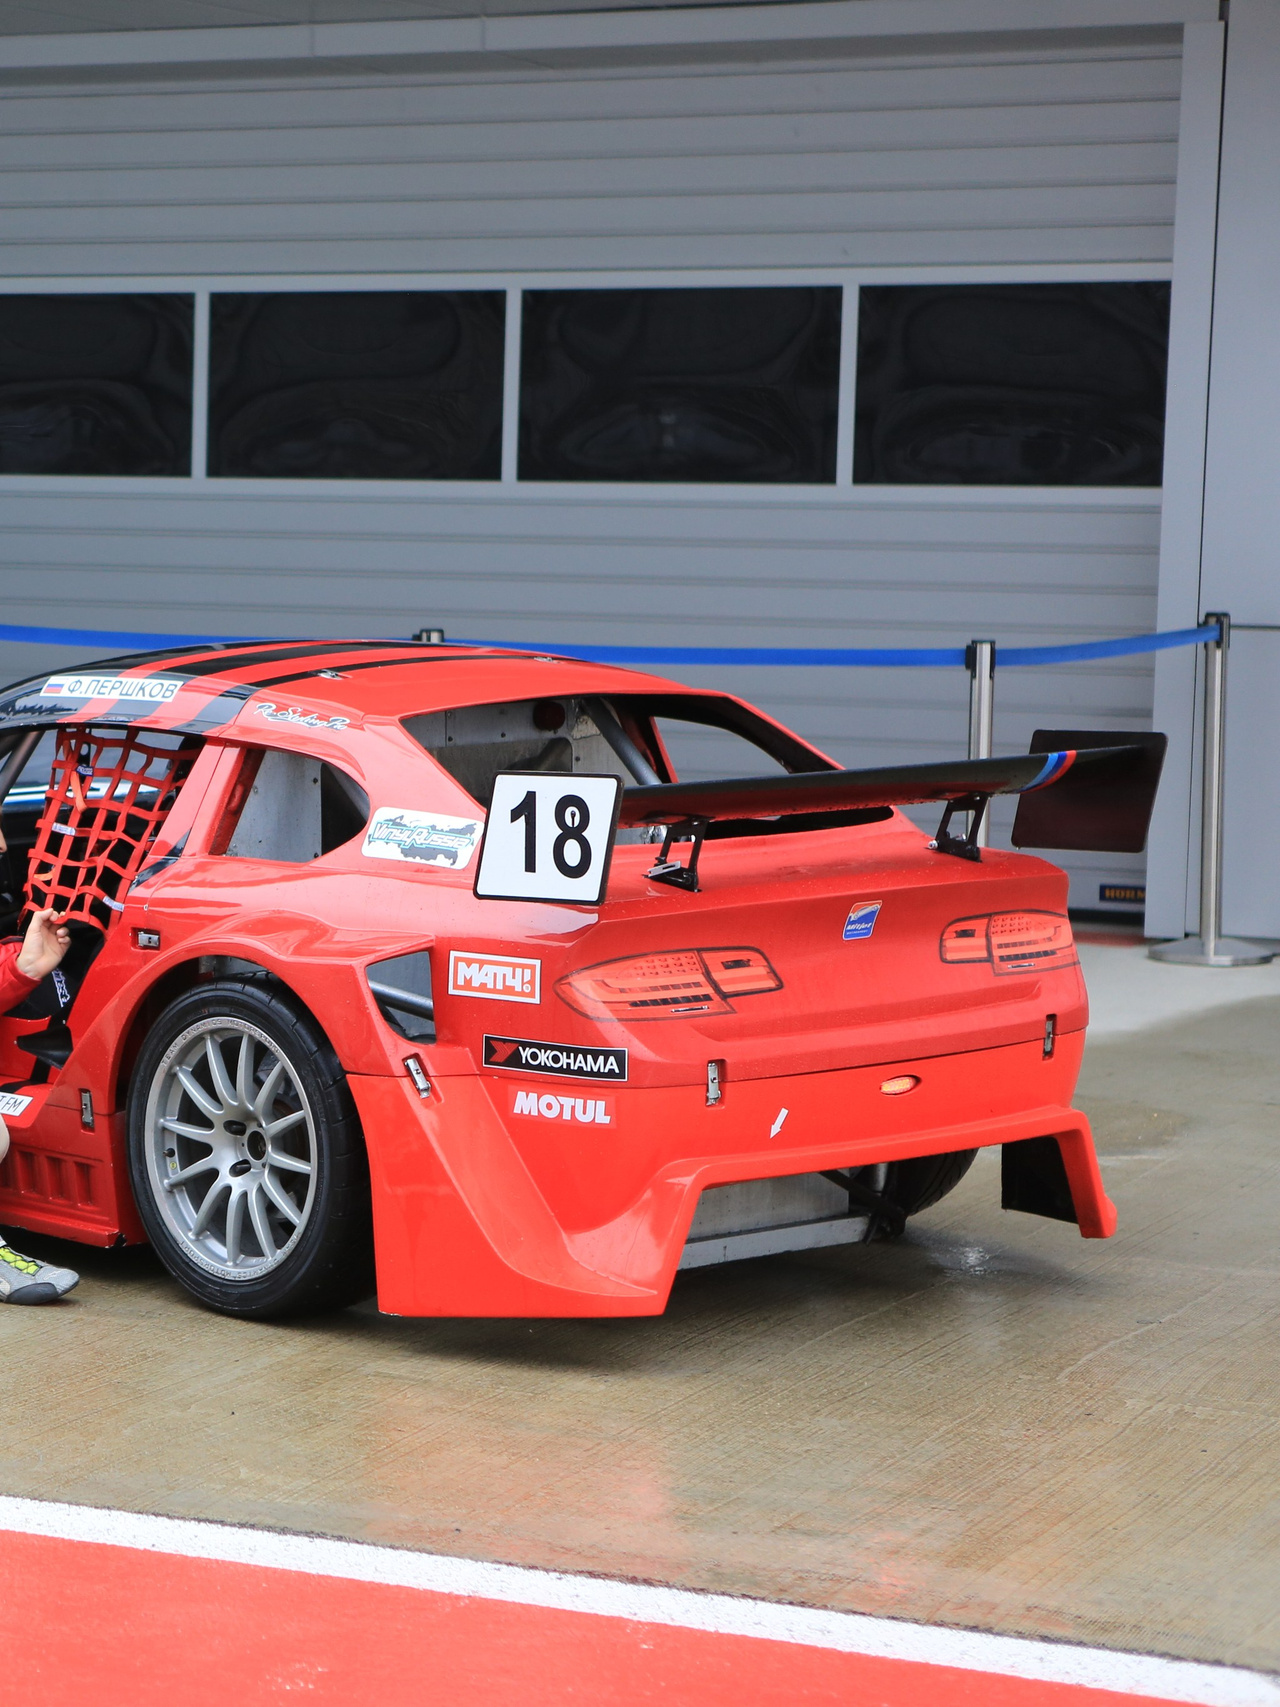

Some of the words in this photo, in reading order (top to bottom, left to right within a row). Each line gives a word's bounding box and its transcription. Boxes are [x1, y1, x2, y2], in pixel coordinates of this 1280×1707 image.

[67, 678, 178, 699] Ф.ПЕРШКОВ
[510, 790, 592, 879] 18
[518, 1046, 620, 1074] YOKOHAMA
[513, 1091, 612, 1124] MOTUL
